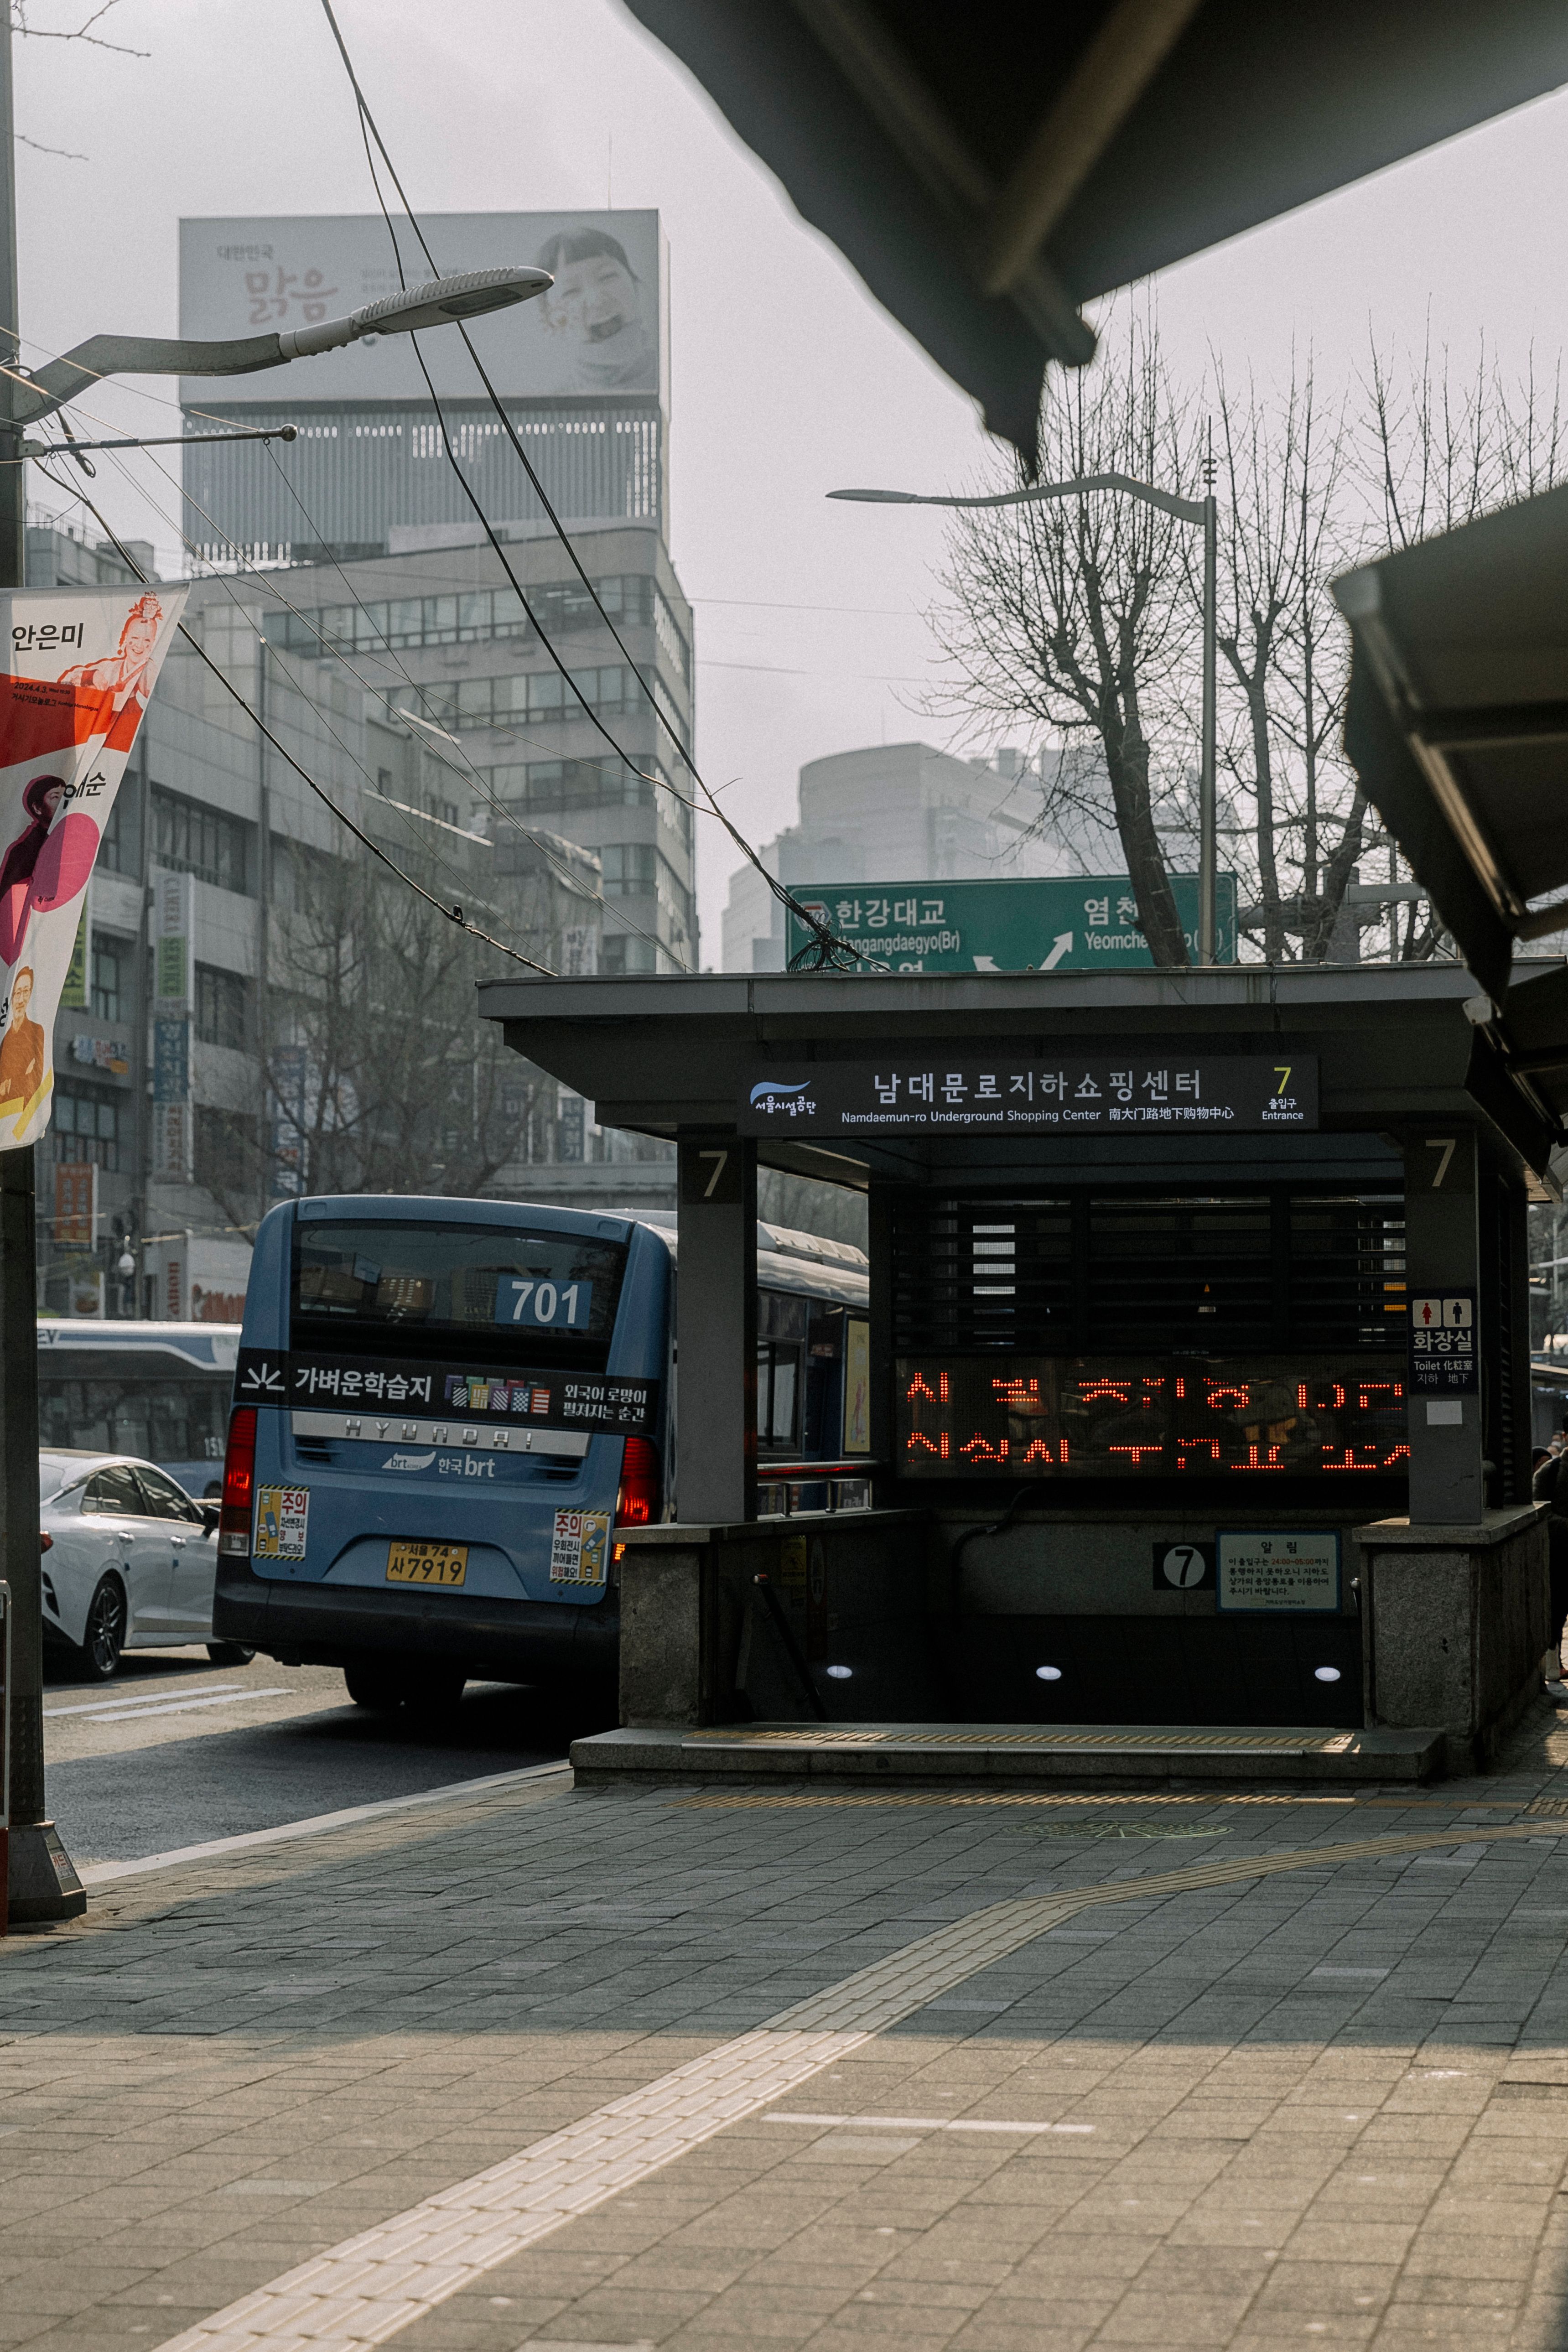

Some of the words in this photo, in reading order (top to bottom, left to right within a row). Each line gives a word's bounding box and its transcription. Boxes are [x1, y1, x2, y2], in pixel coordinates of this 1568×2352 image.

[217, 244, 273, 261] 대한민국
[245, 266, 339, 324] 맑음
[12, 623, 84, 651] 안은미
[836, 898, 946, 929] 한강대교
[1084, 896, 1140, 926] 염천
[874, 1070, 1199, 1104] 남대문로지하쇼핑센터
[1274, 1067, 1291, 1095] 7
[755, 1095, 816, 1117] 서울시설공단
[1268, 1098, 1297, 1109] 출입구
[841, 1112, 926, 1123] Namdaemun-ro
[931, 1111, 1003, 1124] Underground
[1007, 1110, 1059, 1123] Shopping
[1063, 1109, 1101, 1121] Center
[1109, 1107, 1235, 1121] 南大门路地下购物中心
[1262, 1110, 1303, 1121] Entrance
[699, 1151, 727, 1197] 7
[1425, 1139, 1456, 1187] 7
[511, 1281, 578, 1324] 701
[1413, 1330, 1472, 1351] 화장실
[1414, 1361, 1440, 1371] Toilet
[1443, 1360, 1473, 1371] 化粧室
[296, 1367, 431, 1402] 가벼운학습지
[1417, 1373, 1439, 1385] 지하
[1448, 1373, 1469, 1384] 地下
[565, 1384, 604, 1401] 외국어
[607, 1388, 647, 1404] 로망이
[563, 1402, 614, 1420] 펼쳐지는
[619, 1406, 646, 1423] 순간
[346, 1419, 531, 1450] HYUNDAI
[391, 1458, 407, 1469] brt
[438, 1458, 462, 1475] 한국
[465, 1454, 495, 1478] brt
[281, 1492, 307, 1516] 주의
[556, 1514, 582, 1539] 주의
[409, 1545, 428, 1557] 서울
[431, 1546, 449, 1558] 74
[554, 1540, 580, 1552] 우회전시
[553, 1552, 579, 1566] 끼어들면
[1174, 1549, 1194, 1586] 7
[1239, 1558, 1269, 1566] 출입구는
